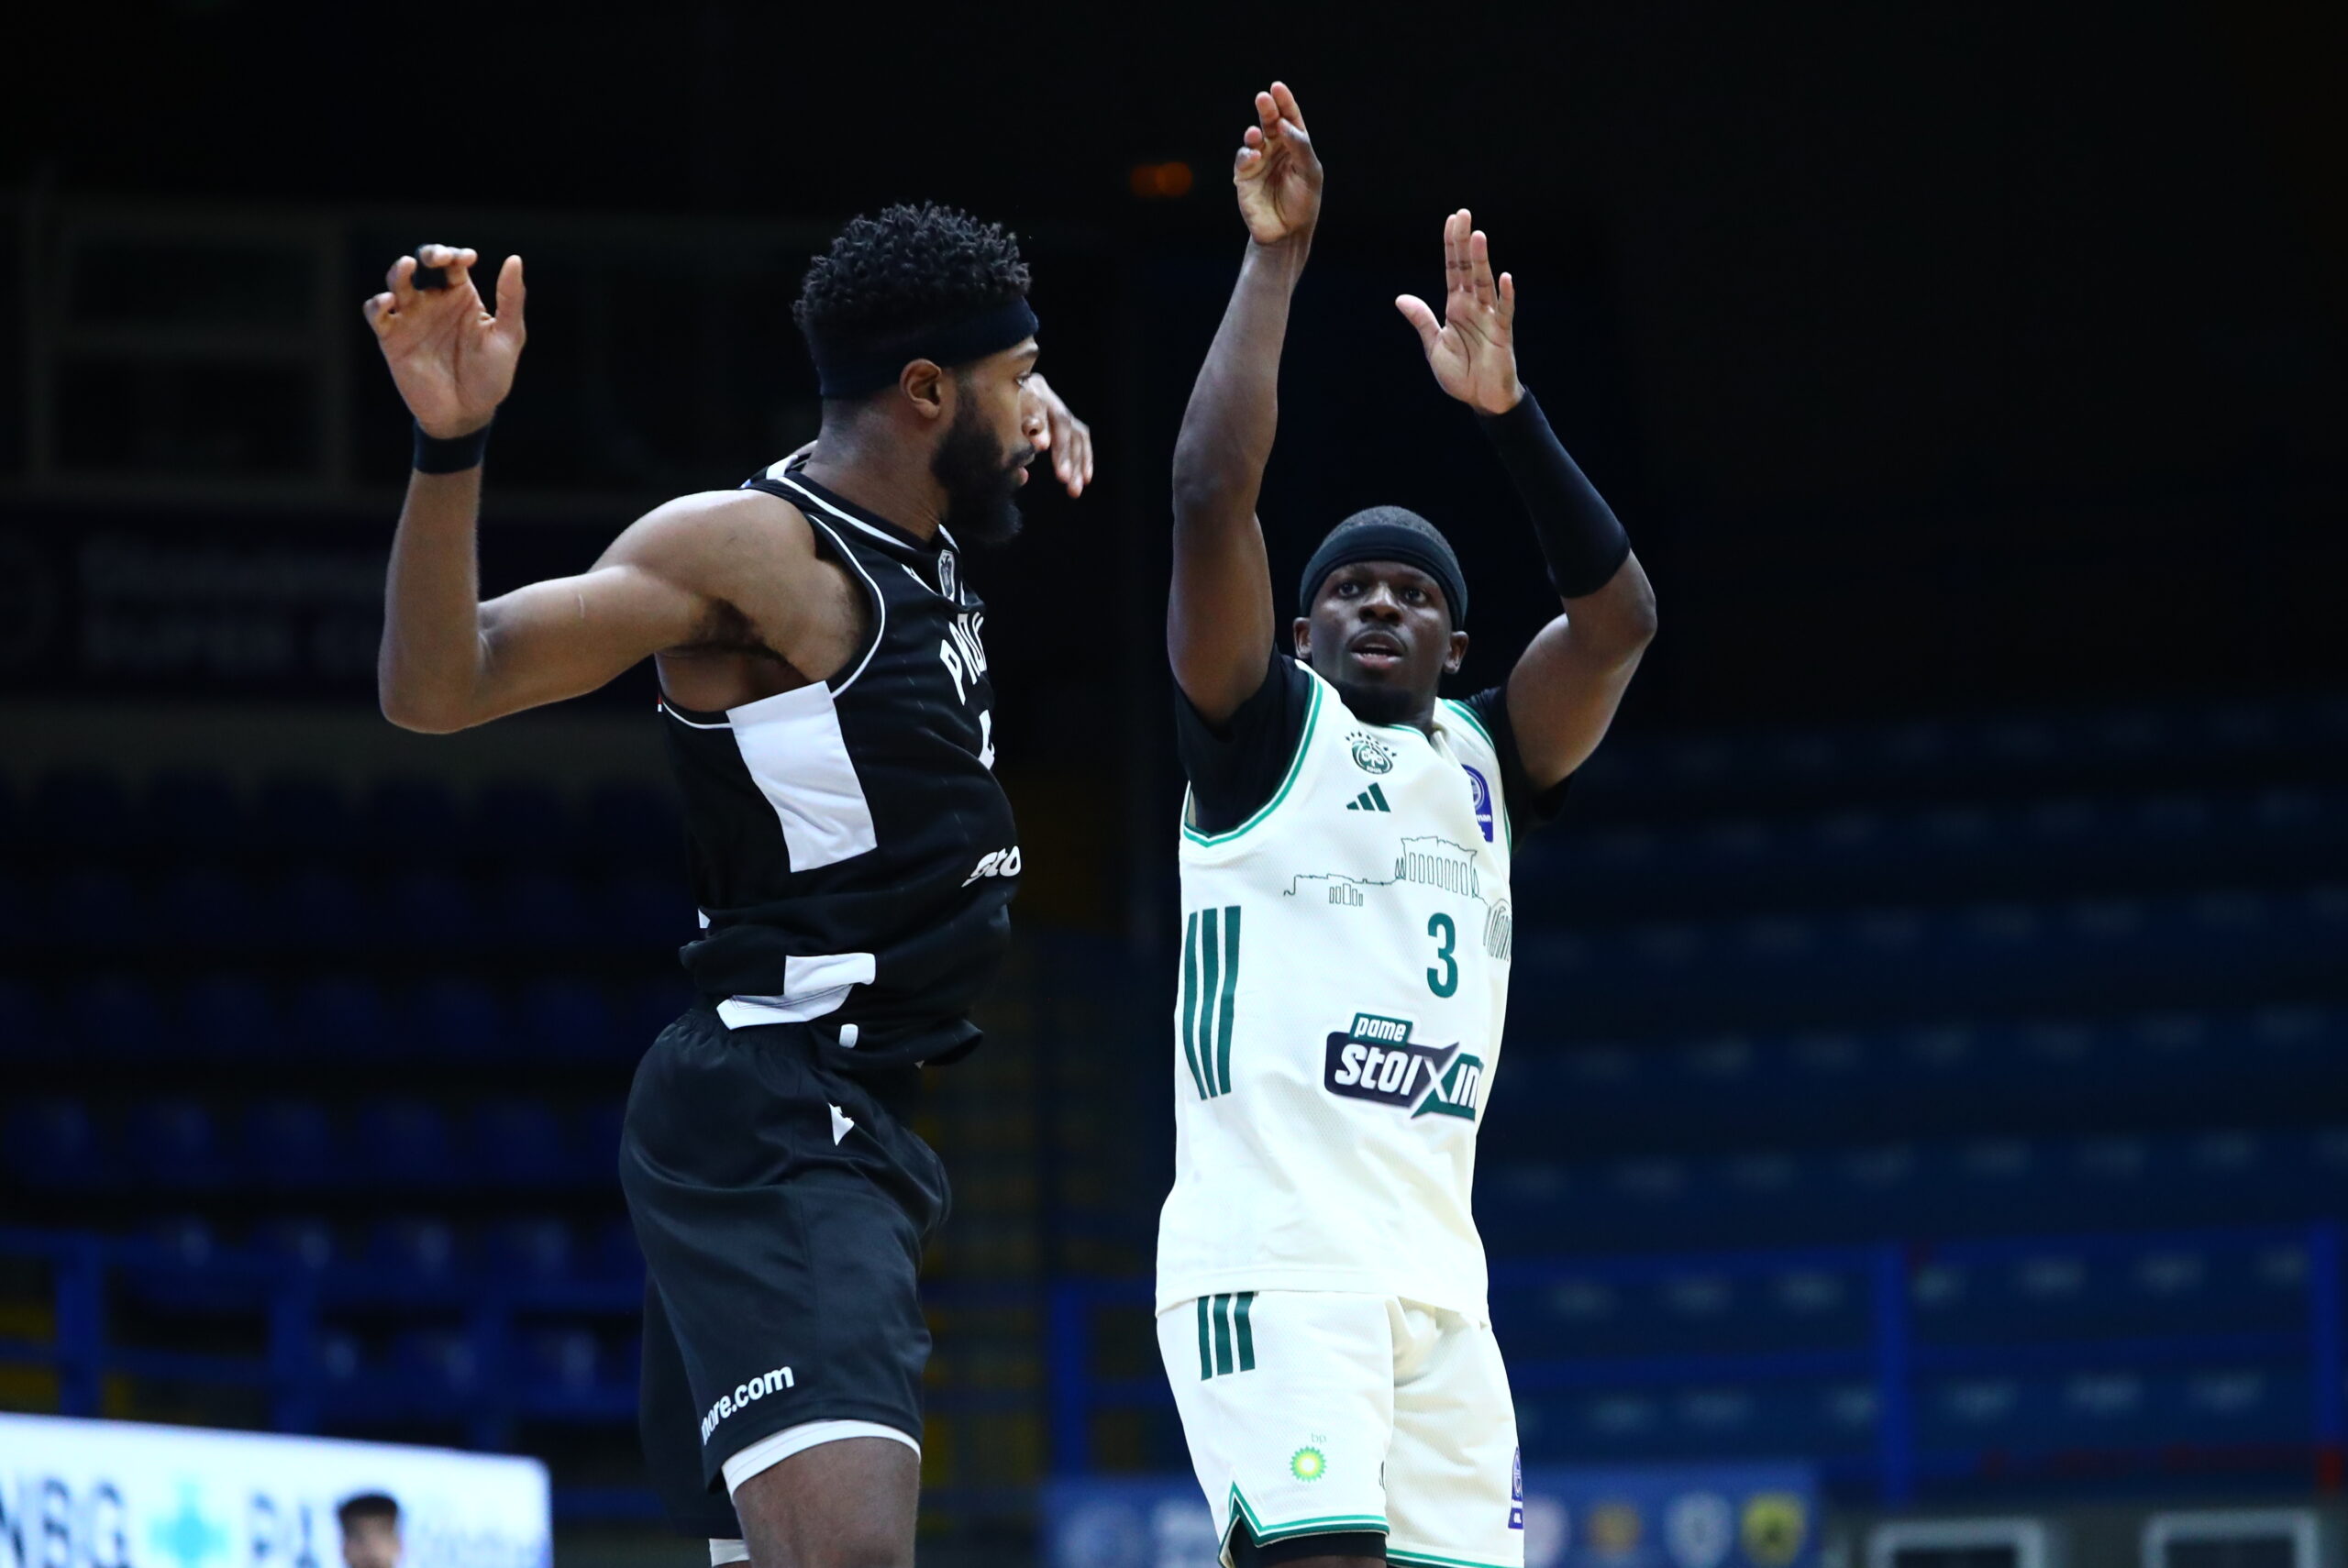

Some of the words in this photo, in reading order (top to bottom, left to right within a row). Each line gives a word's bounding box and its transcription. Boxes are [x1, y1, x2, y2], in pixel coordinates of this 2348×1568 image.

[1426, 911, 1459, 999] 3
[1354, 1017, 1407, 1043] pame
[1311, 1432, 1328, 1446] bp
